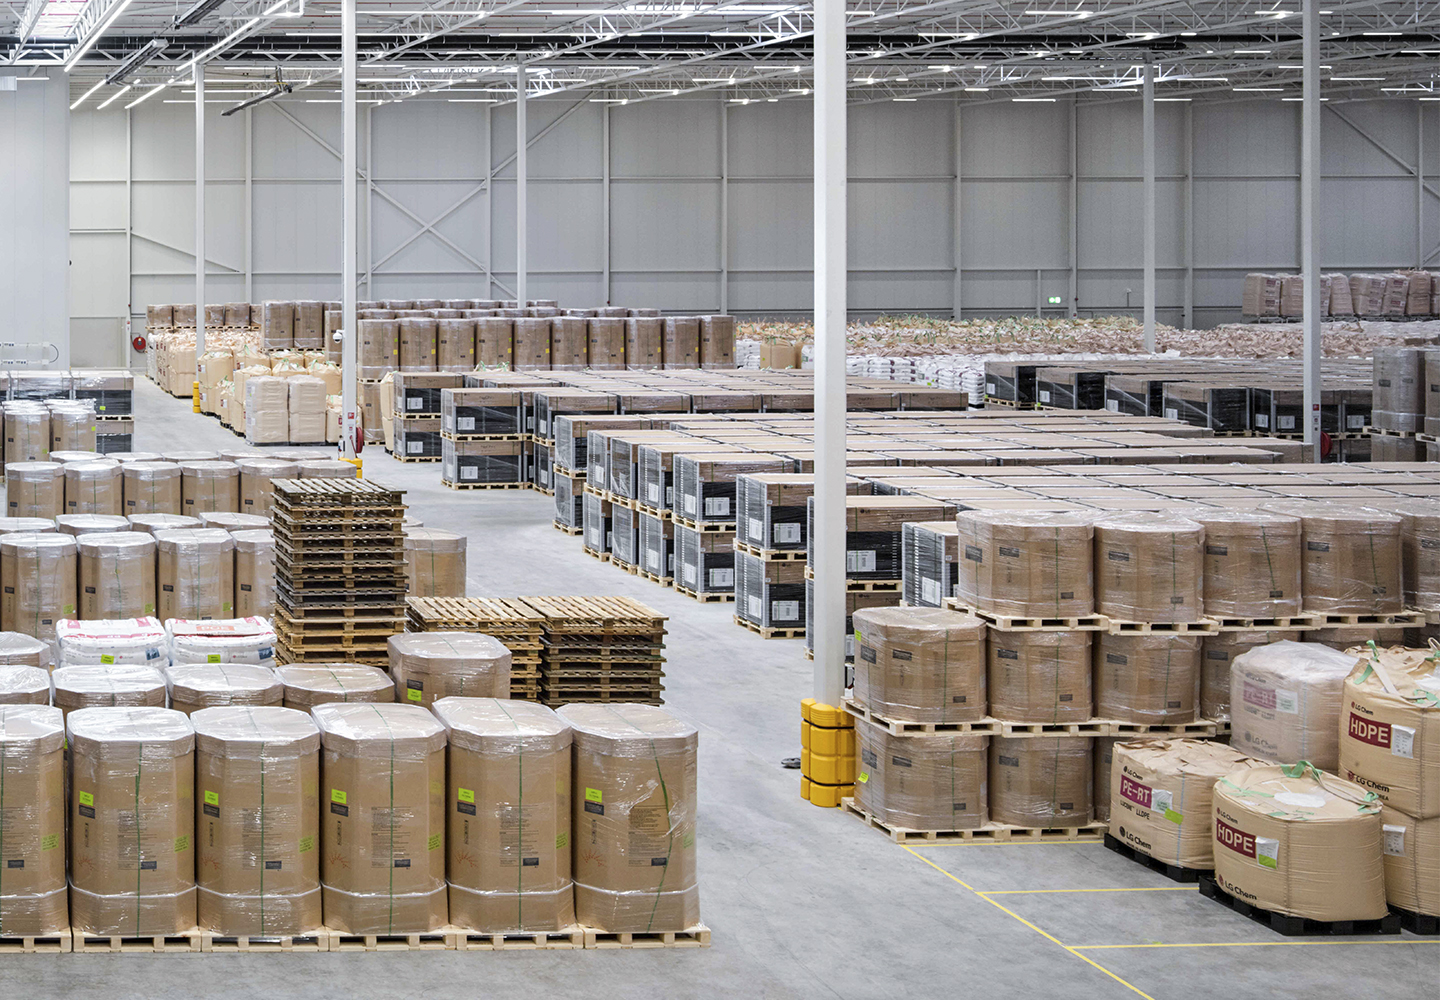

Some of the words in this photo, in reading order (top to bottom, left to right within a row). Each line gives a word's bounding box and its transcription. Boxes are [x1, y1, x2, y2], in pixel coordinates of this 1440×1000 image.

[1361, 706, 1374, 716] Chem
[1350, 717, 1389, 744] HDPE
[1122, 780, 1150, 803] PE-RT
[1355, 776, 1365, 785] LG
[1367, 779, 1390, 793] Chem
[1226, 813, 1238, 824] Chem
[1126, 831, 1134, 842] LG
[1134, 836, 1151, 850] Chem
[1217, 823, 1254, 854] HDPE
[1225, 880, 1234, 891] LG
[1234, 885, 1257, 900] Chem
